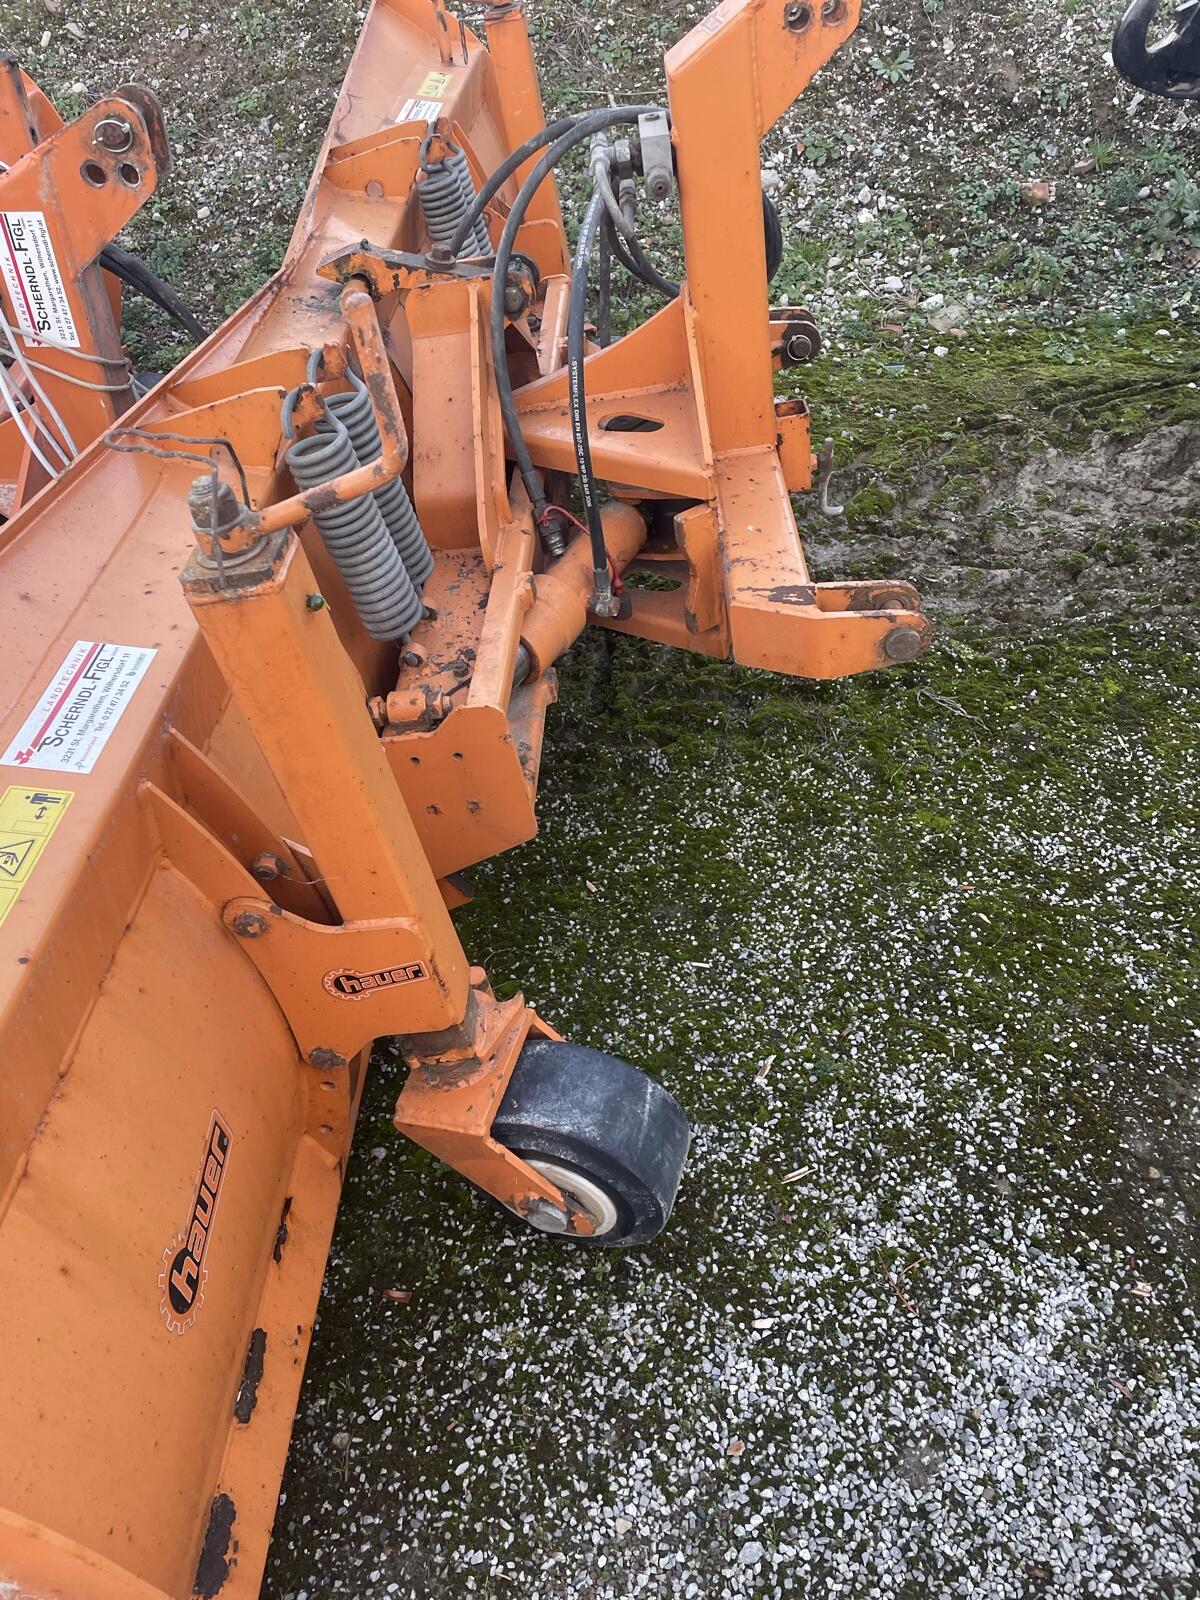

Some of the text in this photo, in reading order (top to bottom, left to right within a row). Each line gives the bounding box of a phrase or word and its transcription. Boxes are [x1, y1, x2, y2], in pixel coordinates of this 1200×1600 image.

[26, 219, 34, 227] 11
[29, 229, 45, 268] Wilhersdorf
[5, 257, 31, 328] LANDTECHNIK
[12, 219, 51, 333] SCHERNDL-FIGL
[44, 270, 58, 314] Margarethen,
[57, 326, 67, 340] 3231
[571, 360, 579, 408] SYSTEMFLEX
[575, 422, 581, 432] EN
[40, 656, 114, 749] SCHERNDL-FIGL
[43, 649, 88, 712] LANDTECHNIK
[59, 747, 76, 763] 3231
[69, 736, 82, 746] St.
[77, 695, 107, 737] Margarethen,
[102, 660, 127, 694] Wilhersdorf
[93, 721, 107, 732] Tel.
[339, 965, 420, 993] hauer
[171, 1126, 226, 1303] hauer
